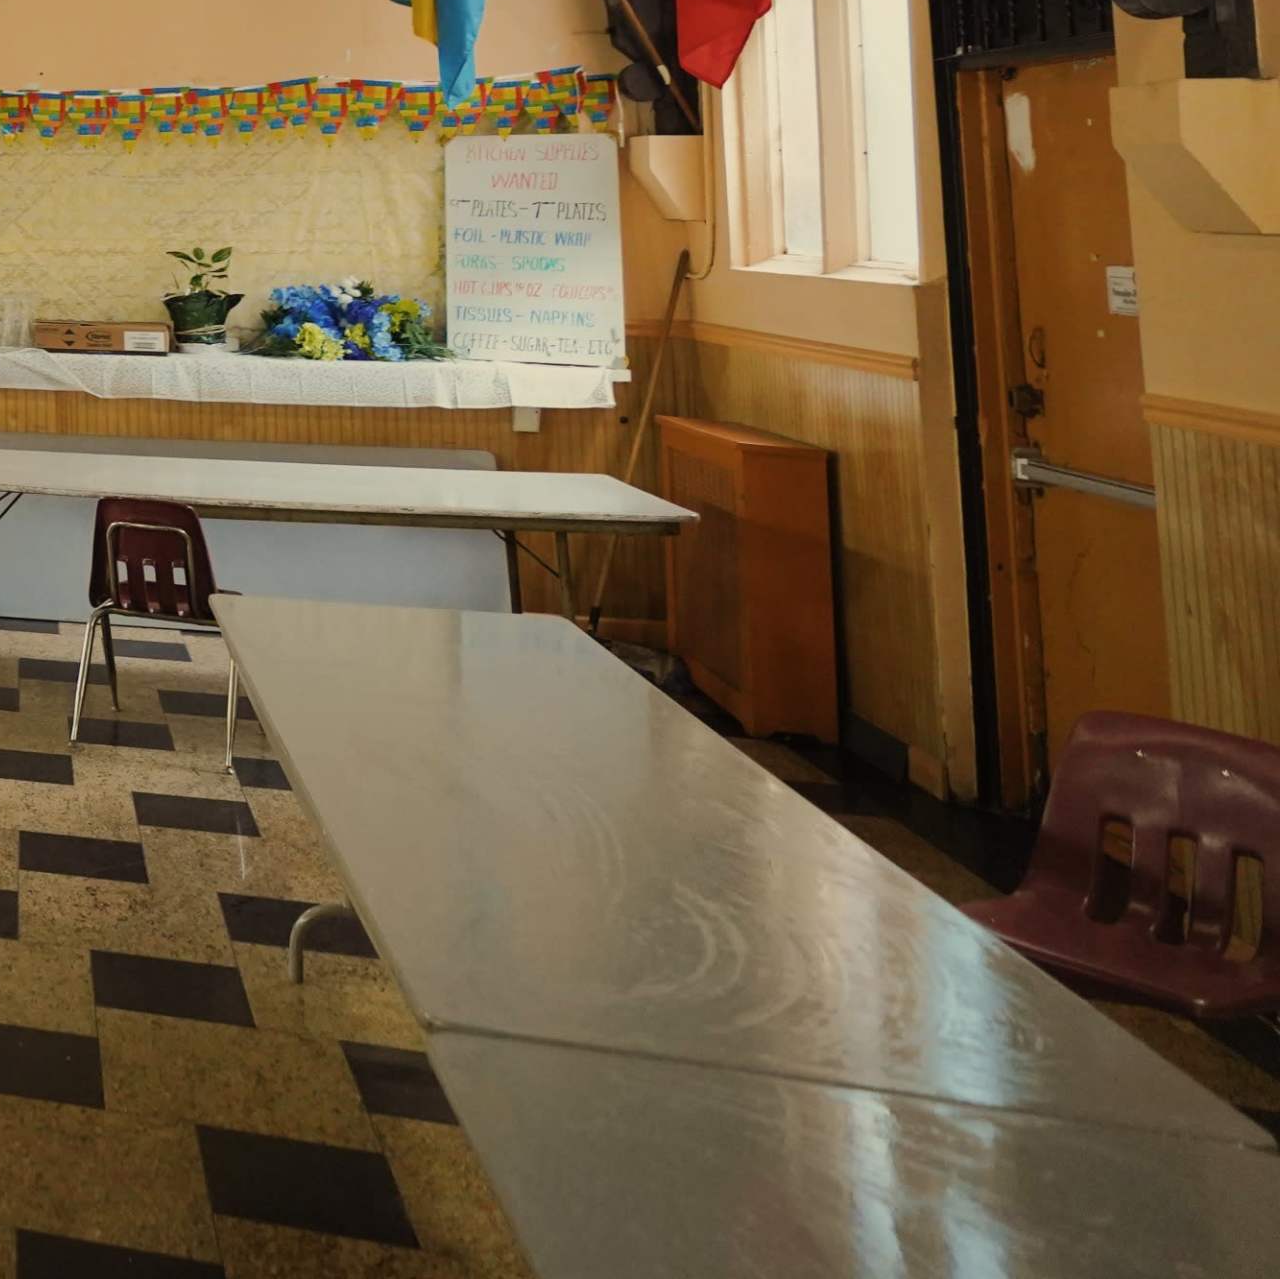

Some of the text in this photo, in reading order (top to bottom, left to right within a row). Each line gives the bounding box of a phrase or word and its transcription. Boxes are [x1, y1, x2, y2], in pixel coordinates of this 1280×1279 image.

[466, 143, 527, 161] KITCHEN
[491, 171, 559, 190] WANTED
[471, 199, 518, 218] PLATES
[453, 227, 484, 243] FOIL
[500, 229, 546, 246] PLASTIC
[456, 305, 513, 322] TISSUES
[530, 309, 595, 328] NAPKINS
